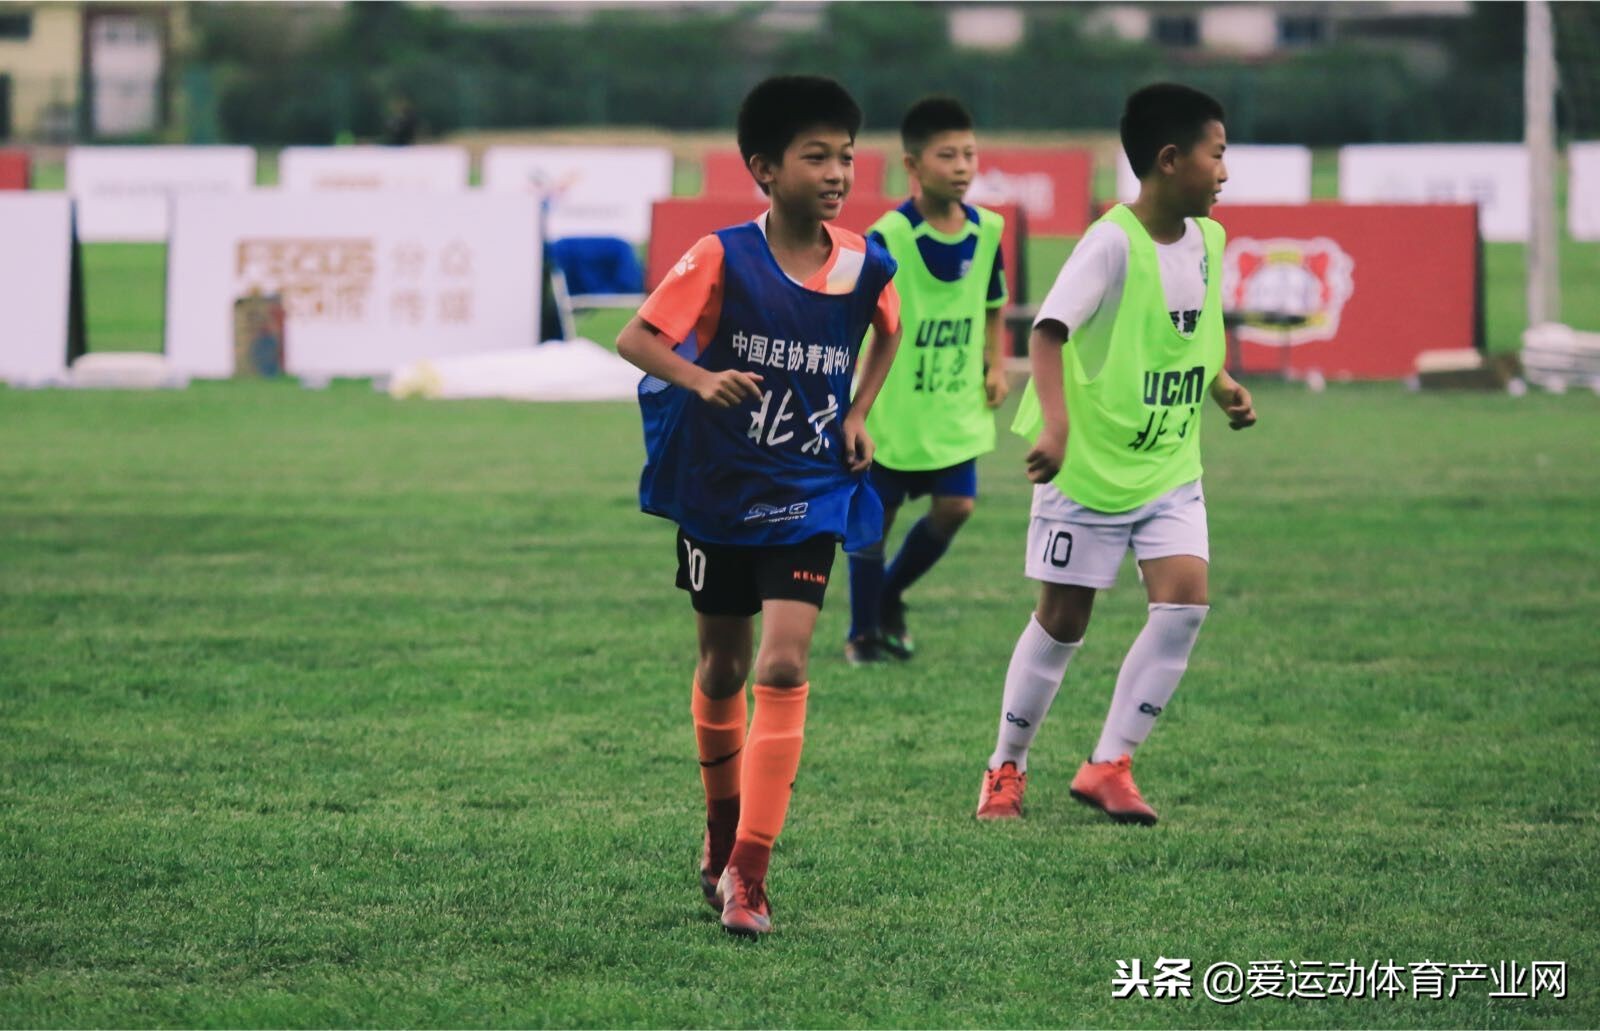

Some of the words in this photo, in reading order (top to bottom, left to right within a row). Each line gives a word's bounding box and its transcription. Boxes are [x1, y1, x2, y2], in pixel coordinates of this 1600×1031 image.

[731, 330, 850, 375] 中国足协青训中心
[747, 388, 839, 455] 北京
[1043, 529, 1073, 568] 10
